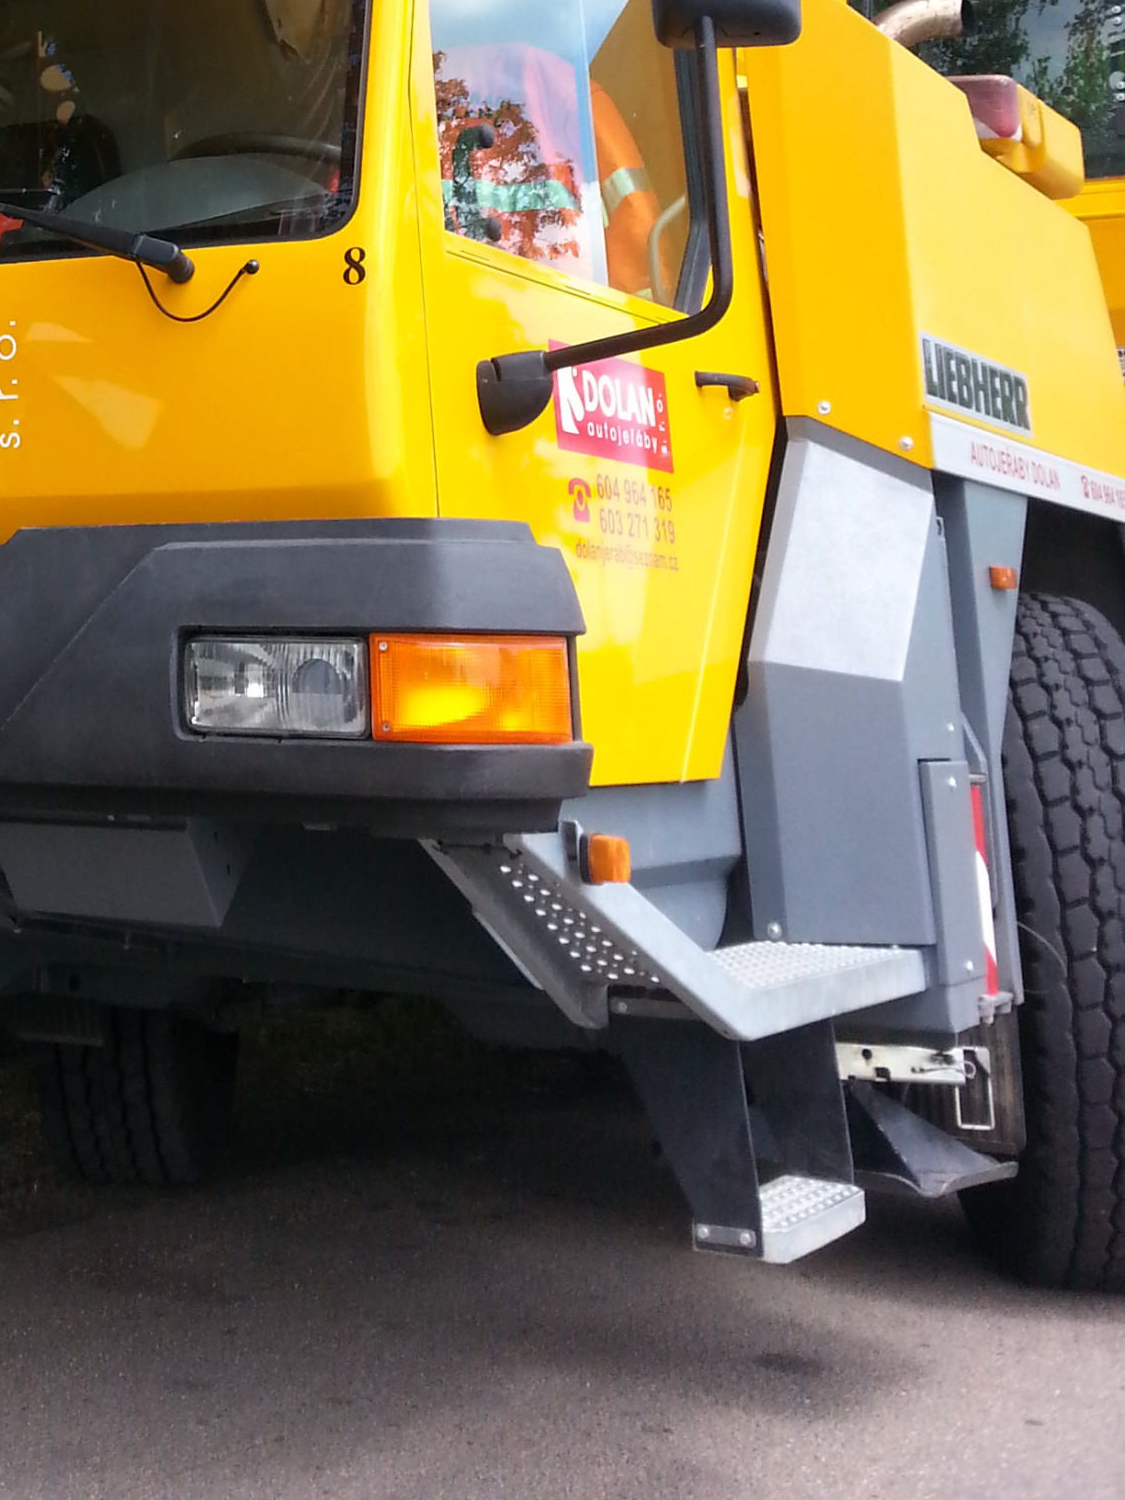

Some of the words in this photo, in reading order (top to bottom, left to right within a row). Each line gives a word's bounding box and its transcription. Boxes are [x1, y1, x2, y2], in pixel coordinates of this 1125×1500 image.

[342, 246, 366, 285] 8
[582, 369, 656, 428] DOLAN
[922, 338, 1031, 431] LIEBHERR
[596, 473, 620, 501] 604
[624, 479, 647, 506] 964
[651, 485, 672, 512] 165
[1031, 462, 1061, 490] DOLAN
[600, 508, 623, 536] 603
[627, 512, 649, 540] 271
[654, 517, 676, 544] 319
